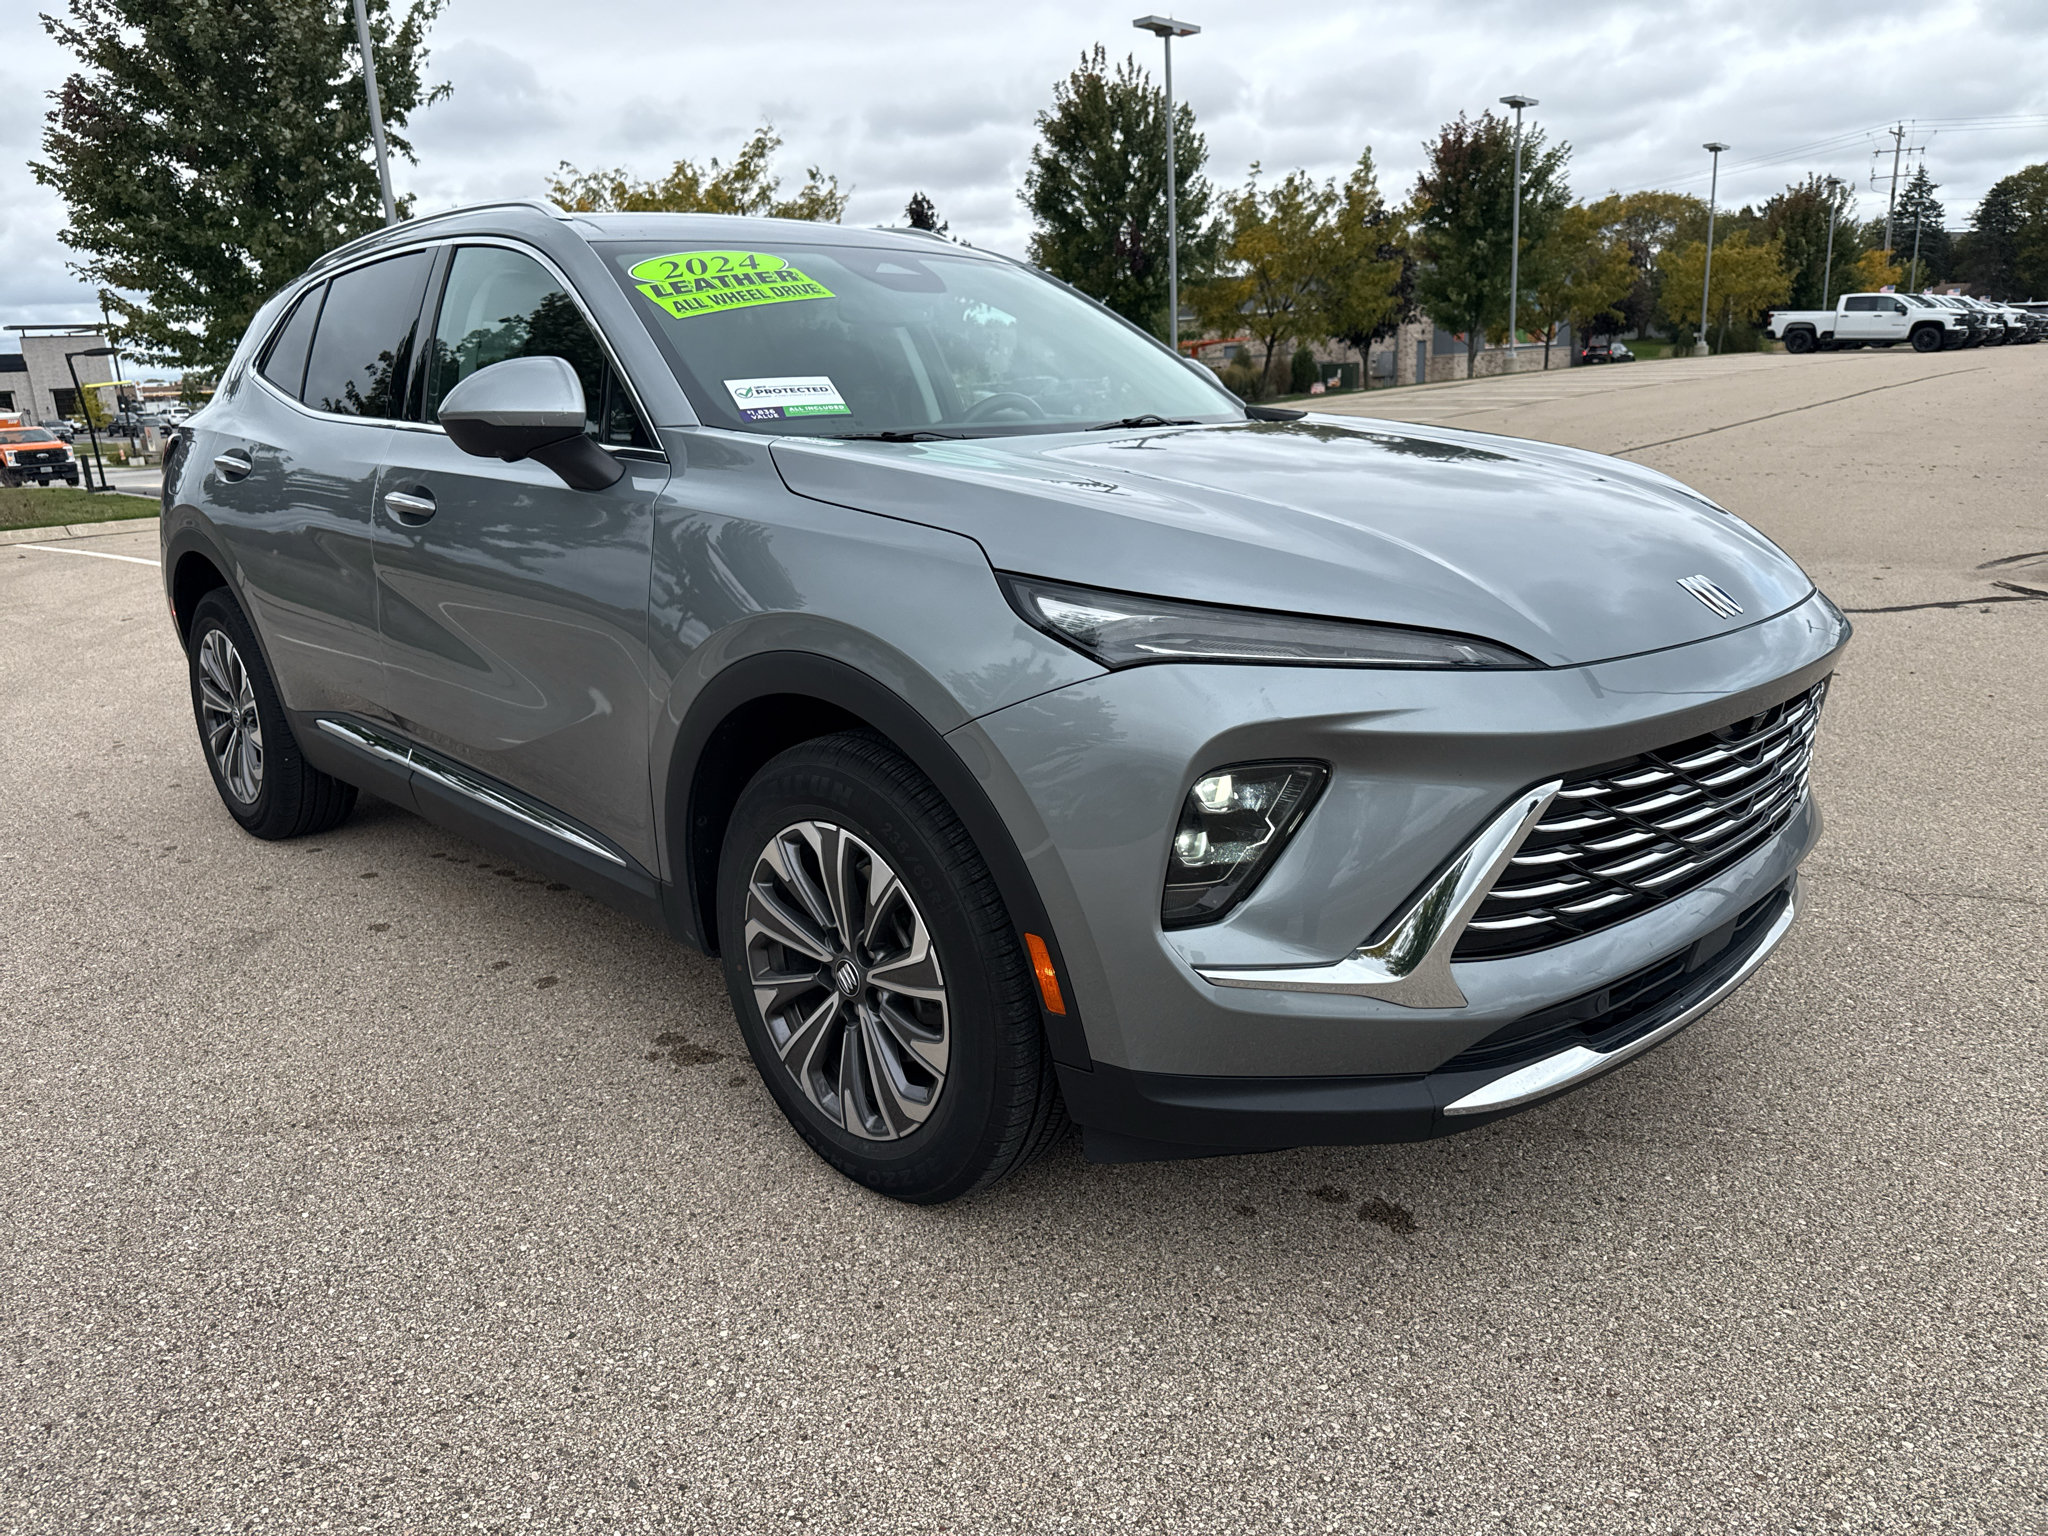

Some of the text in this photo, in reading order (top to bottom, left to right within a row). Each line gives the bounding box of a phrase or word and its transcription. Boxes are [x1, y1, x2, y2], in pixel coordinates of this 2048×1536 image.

[659, 254, 760, 280] 2024
[650, 270, 801, 298] LEATHER
[672, 283, 823, 313] ALL WHEEL DRIVE
[755, 386, 829, 395] PROTECTED
